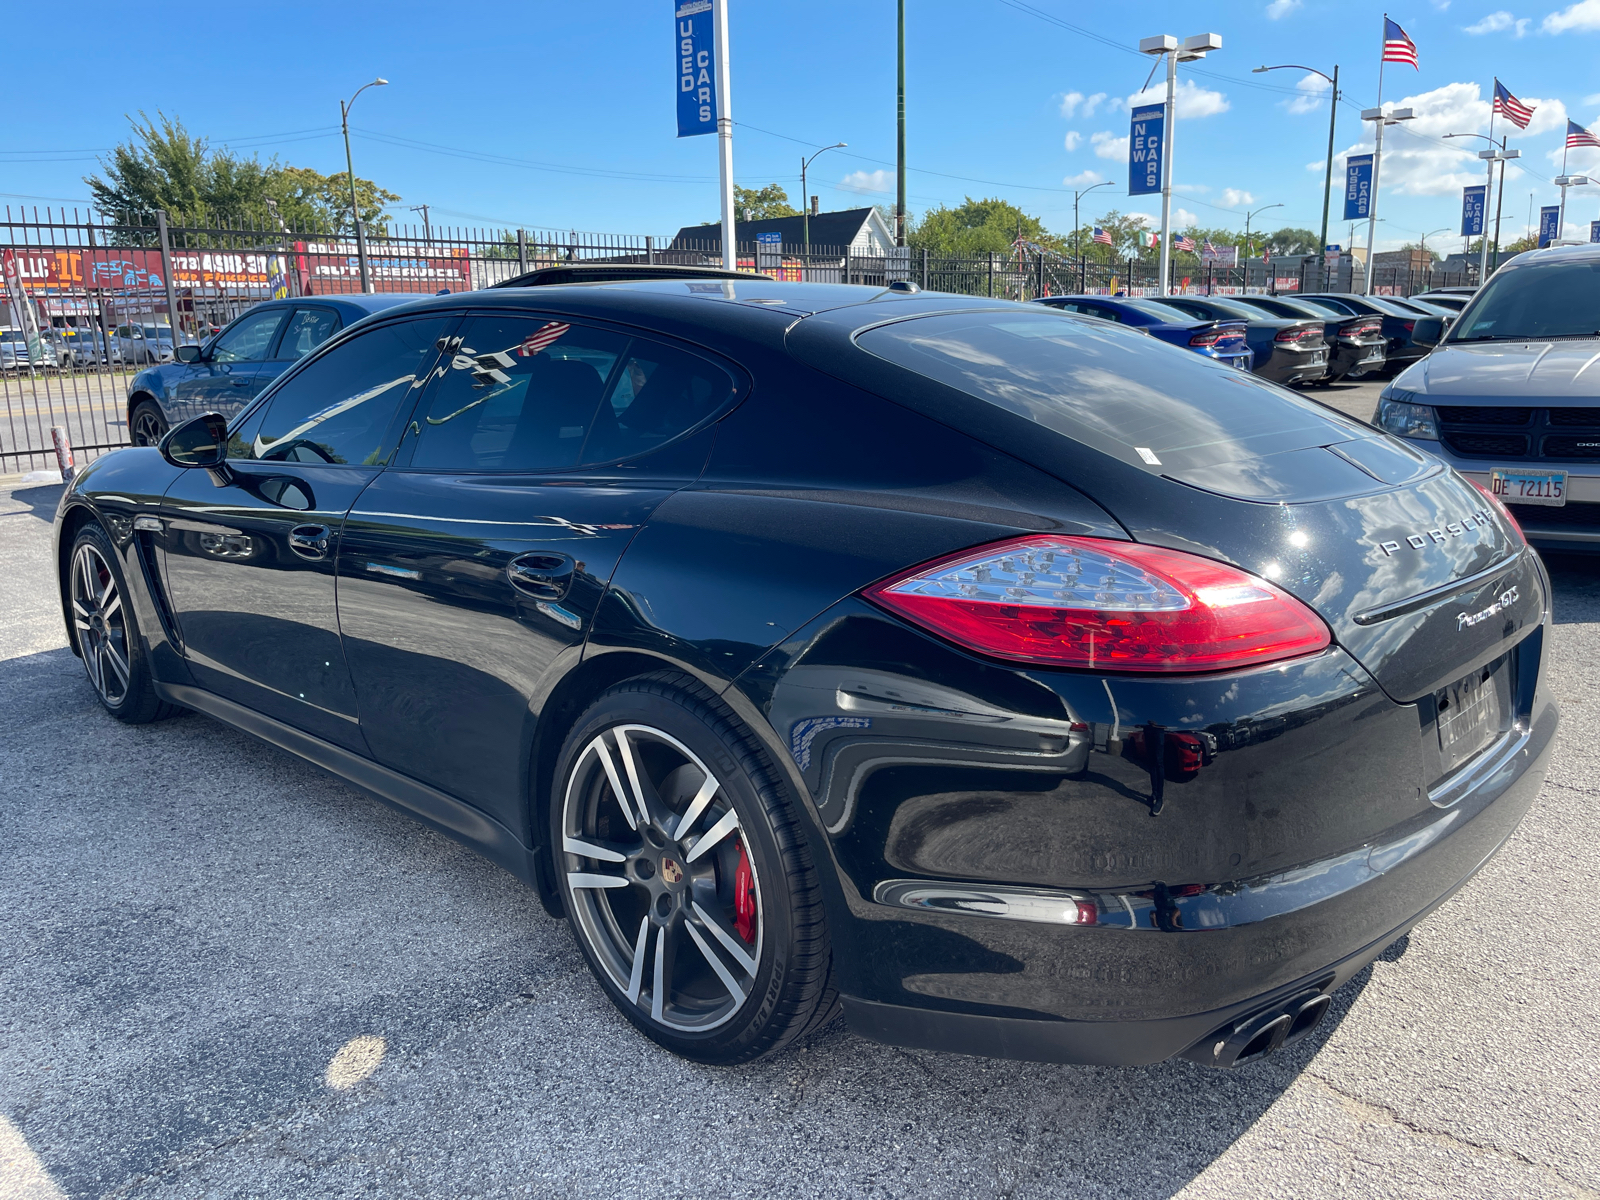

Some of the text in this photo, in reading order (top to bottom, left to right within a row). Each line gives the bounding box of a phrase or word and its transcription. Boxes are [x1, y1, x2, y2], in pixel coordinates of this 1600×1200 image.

[680, 19, 695, 92] USED
[697, 50, 711, 122] CARS
[1133, 123, 1158, 187] NEW CARS
[1348, 167, 1368, 214] USED CARS
[1465, 195, 1474, 218] NEW
[1472, 203, 1481, 232] CARS
[18, 257, 49, 278] LLC
[308, 243, 361, 256] GOLDEN
[345, 258, 430, 268] Cmplete
[375, 267, 460, 278] SERVICE
[1493, 478, 1562, 498] DE 72115
[1379, 508, 1492, 556] PORSCHE
[766, 959, 784, 1008] SPORT
